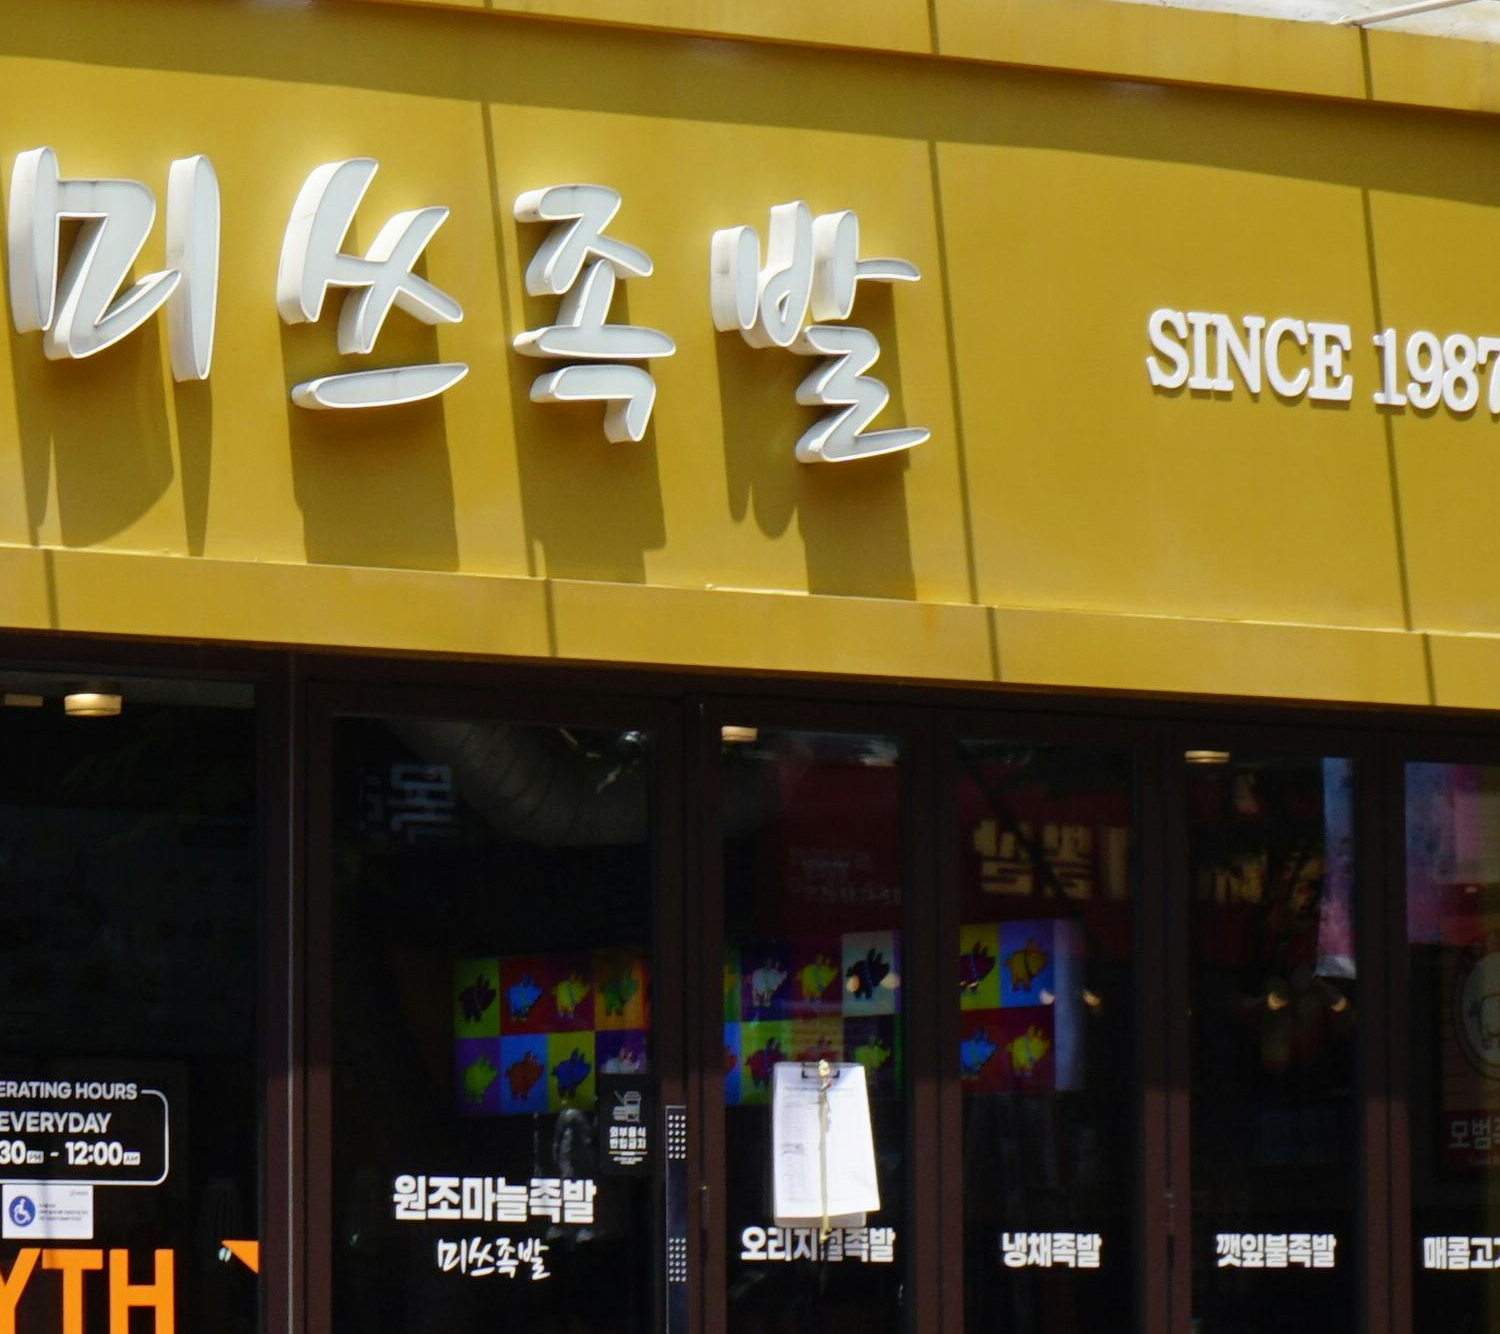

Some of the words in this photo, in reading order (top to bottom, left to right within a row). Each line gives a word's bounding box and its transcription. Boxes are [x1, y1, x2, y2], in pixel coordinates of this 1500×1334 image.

[7, 146, 931, 464] 미쓰족발
[1146, 307, 1353, 404] SINCE
[75, 1082, 138, 1100] HOURS
[65, 1141, 124, 1165] 12:00
[393, 1175, 596, 1223] 원조마늘족발
[438, 1236, 550, 1280] 미쓰족발
[1001, 1231, 1100, 1269] 냉채족발
[1216, 1233, 1336, 1269] 깻잎불족발
